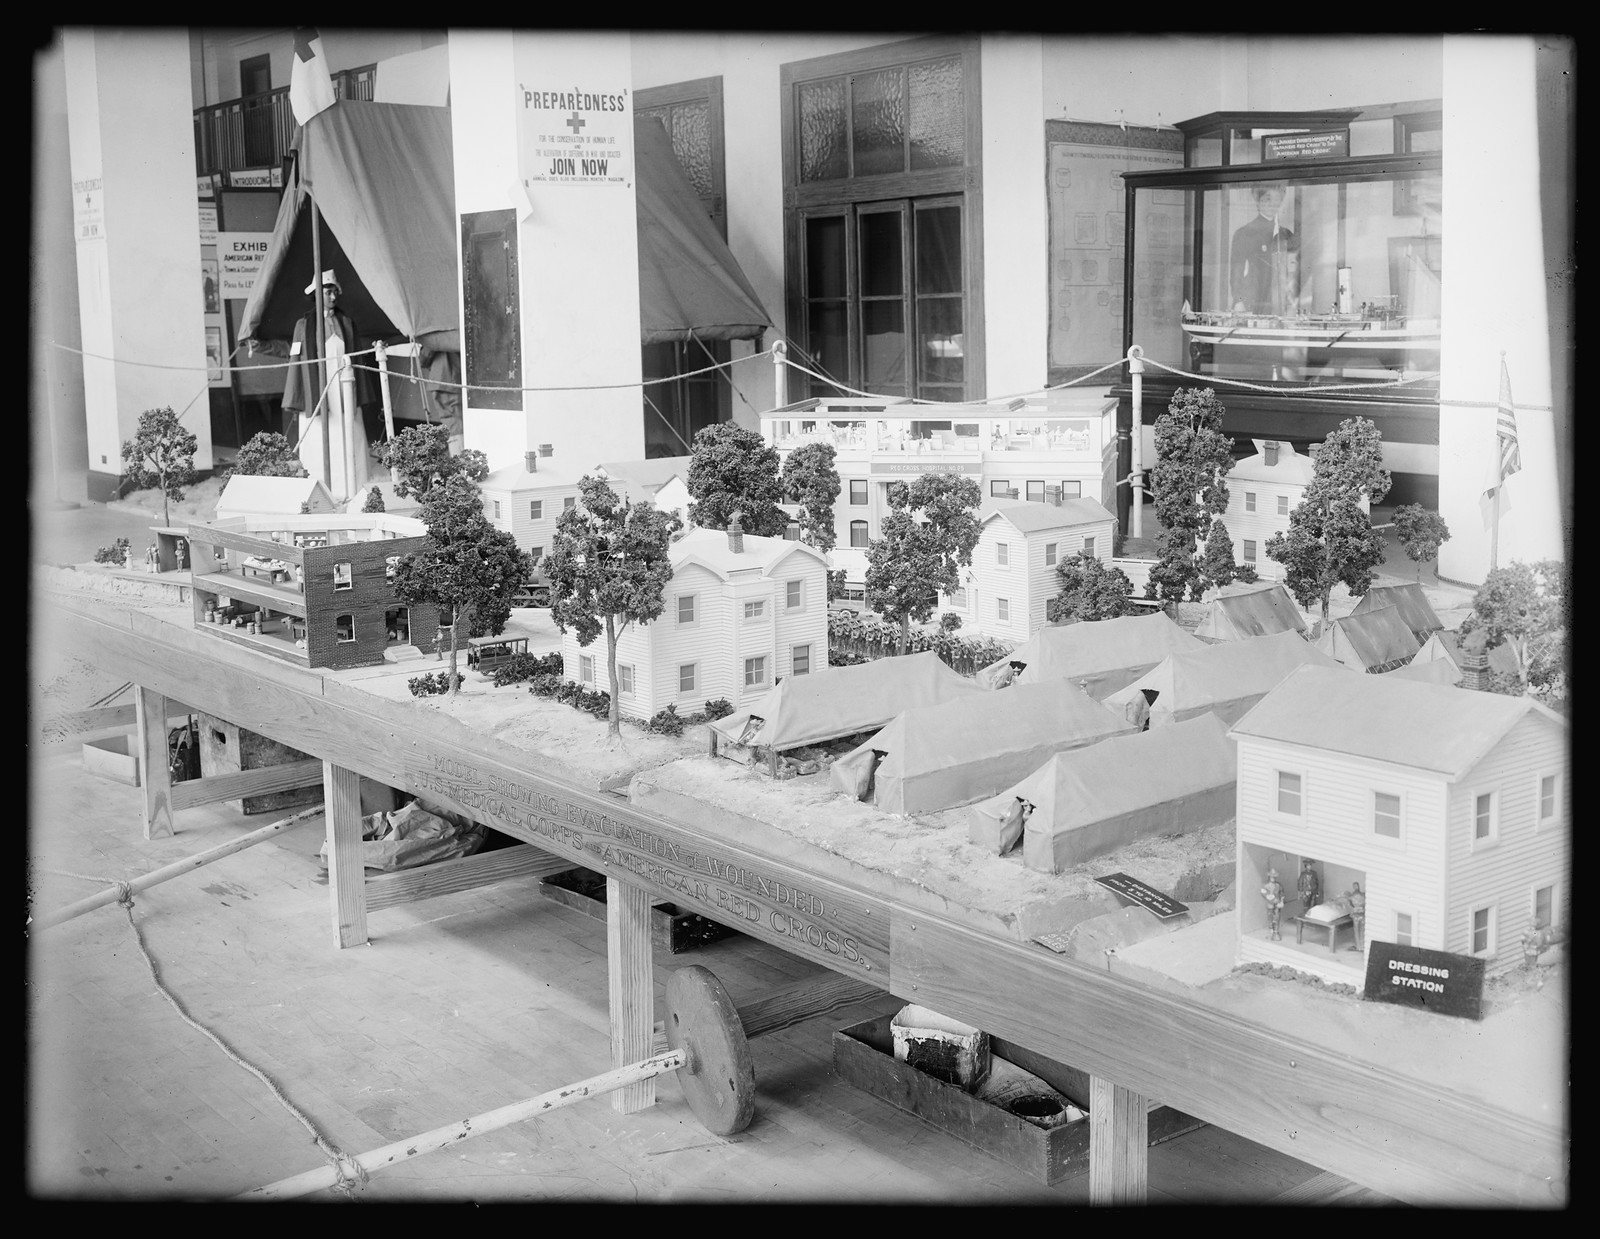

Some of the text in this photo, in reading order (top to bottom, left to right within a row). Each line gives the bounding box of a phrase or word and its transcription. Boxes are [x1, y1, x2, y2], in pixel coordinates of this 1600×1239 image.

[525, 91, 625, 112] PREPAREDNESS
[550, 158, 608, 176] JOIN NOW
[232, 176, 270, 186] INTRODUCING
[434, 754, 482, 785] MODEL
[488, 774, 559, 816] SHOWING
[566, 803, 681, 863] EVACUATION
[706, 855, 825, 919] WOUNDED
[527, 813, 584, 851] CORPS
[602, 845, 709, 902] AMERICAN
[716, 887, 761, 923] RED
[1108, 878, 1127, 888] FROM
[1152, 901, 1173, 913] MILES
[1131, 883, 1164, 902] DISTANCE
[1388, 960, 1450, 979] DRESSING
[1391, 975, 1444, 993] STATION
